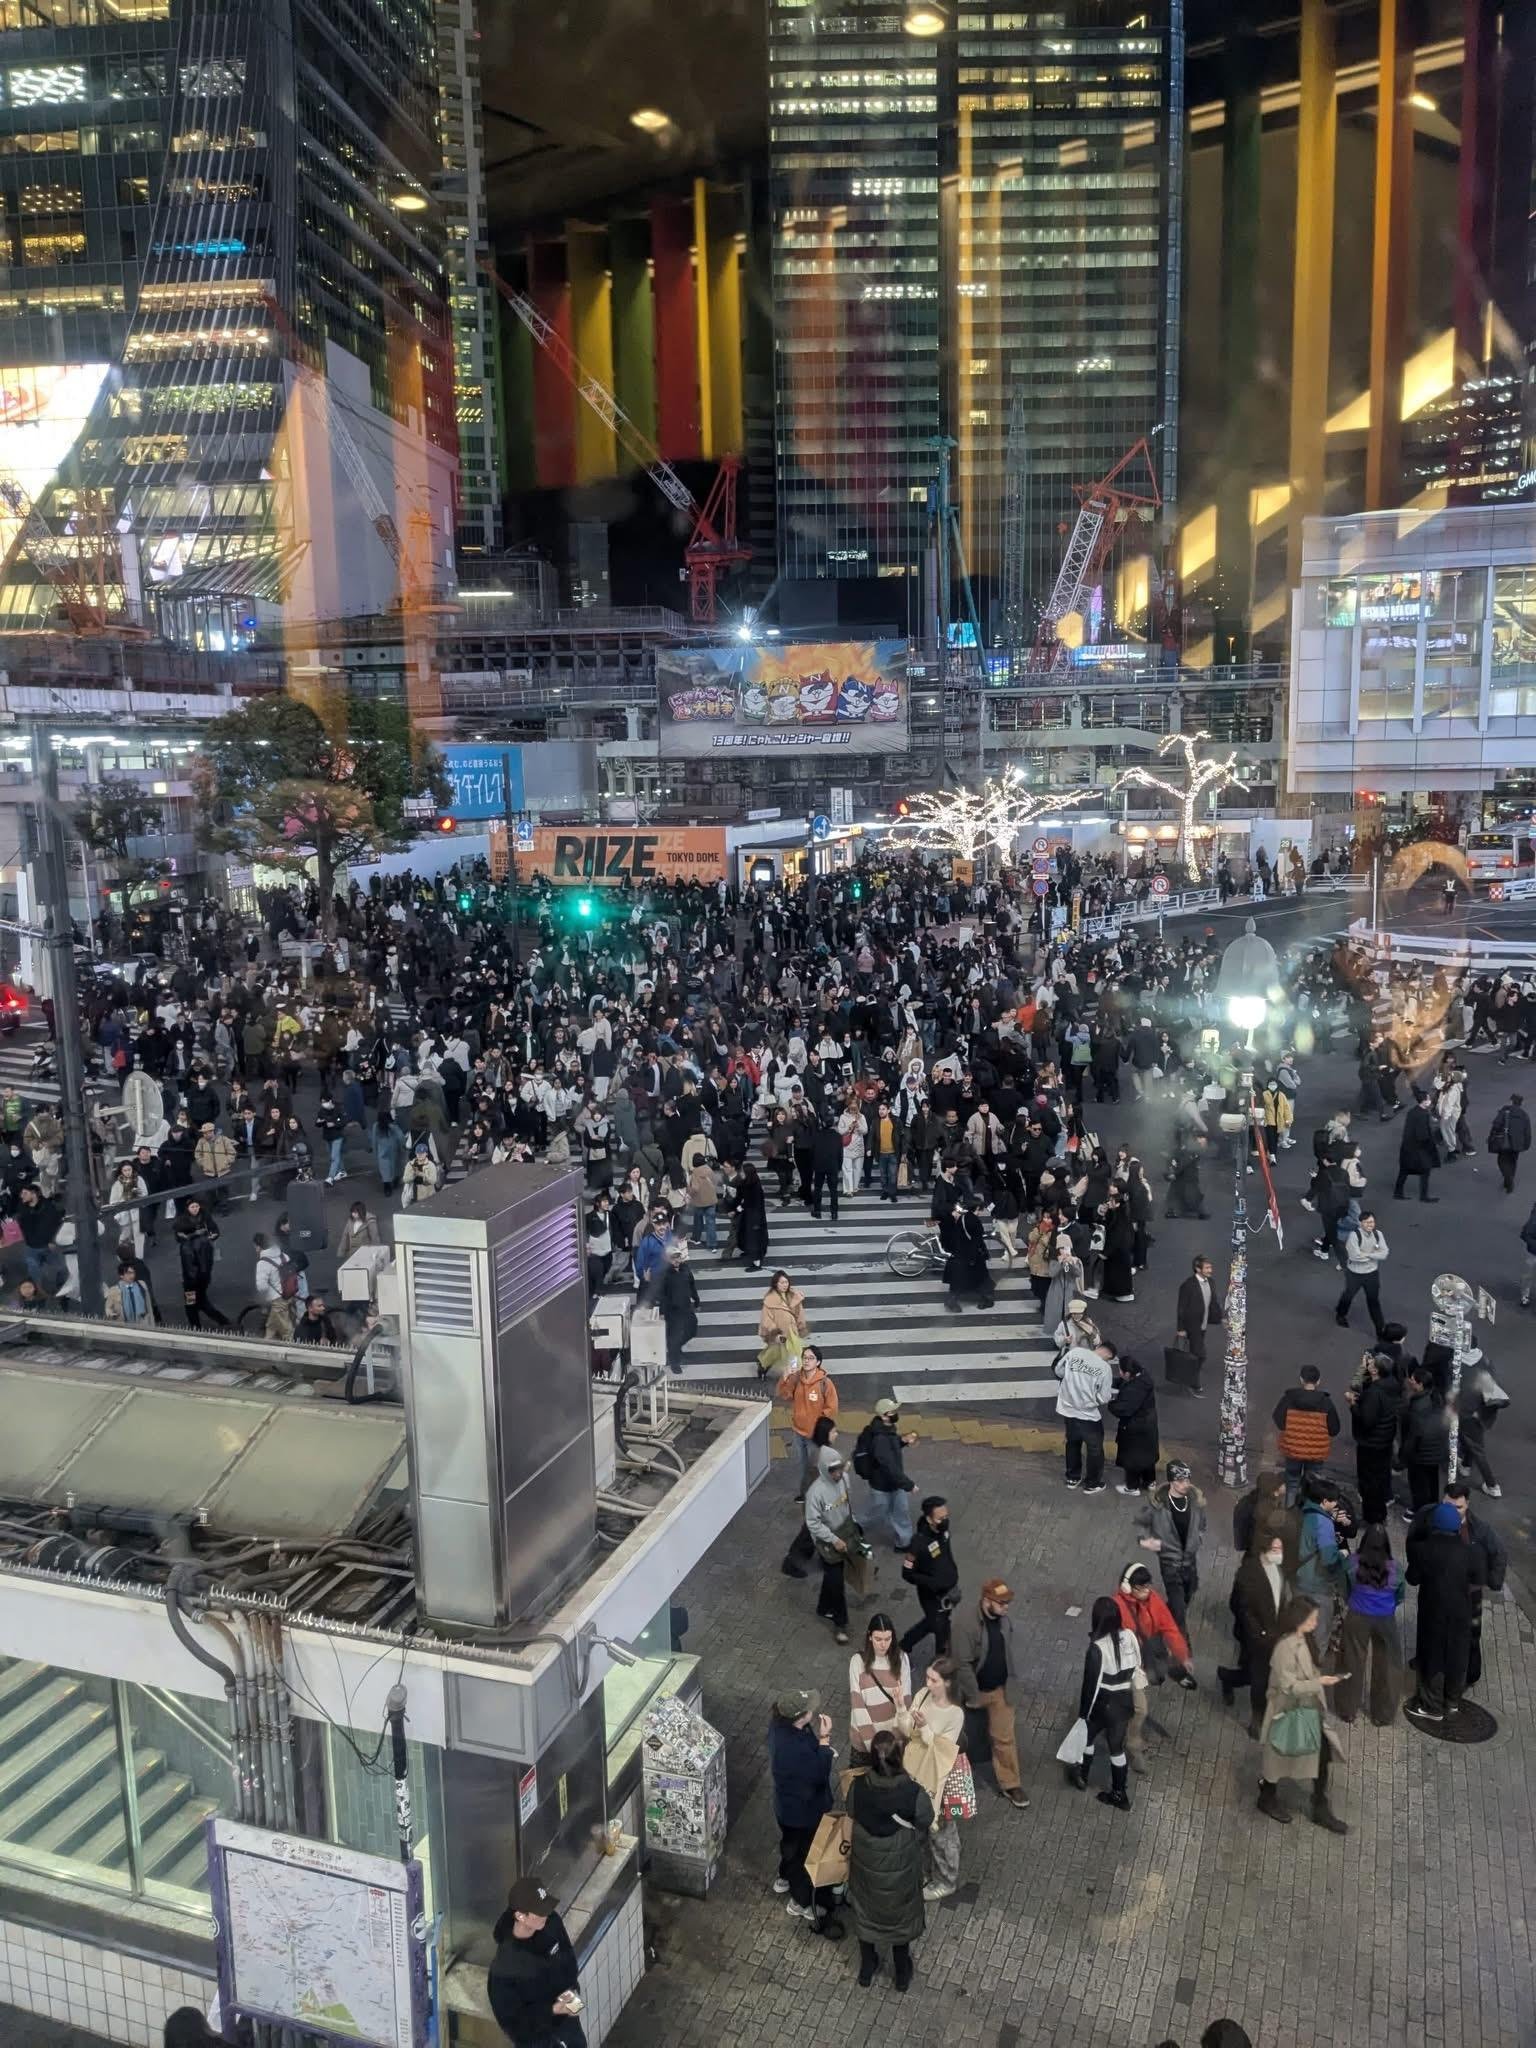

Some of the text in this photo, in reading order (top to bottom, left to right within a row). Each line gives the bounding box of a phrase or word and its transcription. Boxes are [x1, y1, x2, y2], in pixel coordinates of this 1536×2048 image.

[554, 835, 659, 877] RIIZE
[667, 852, 720, 863] TOKYO DOME
[950, 1807, 963, 1816] GU
